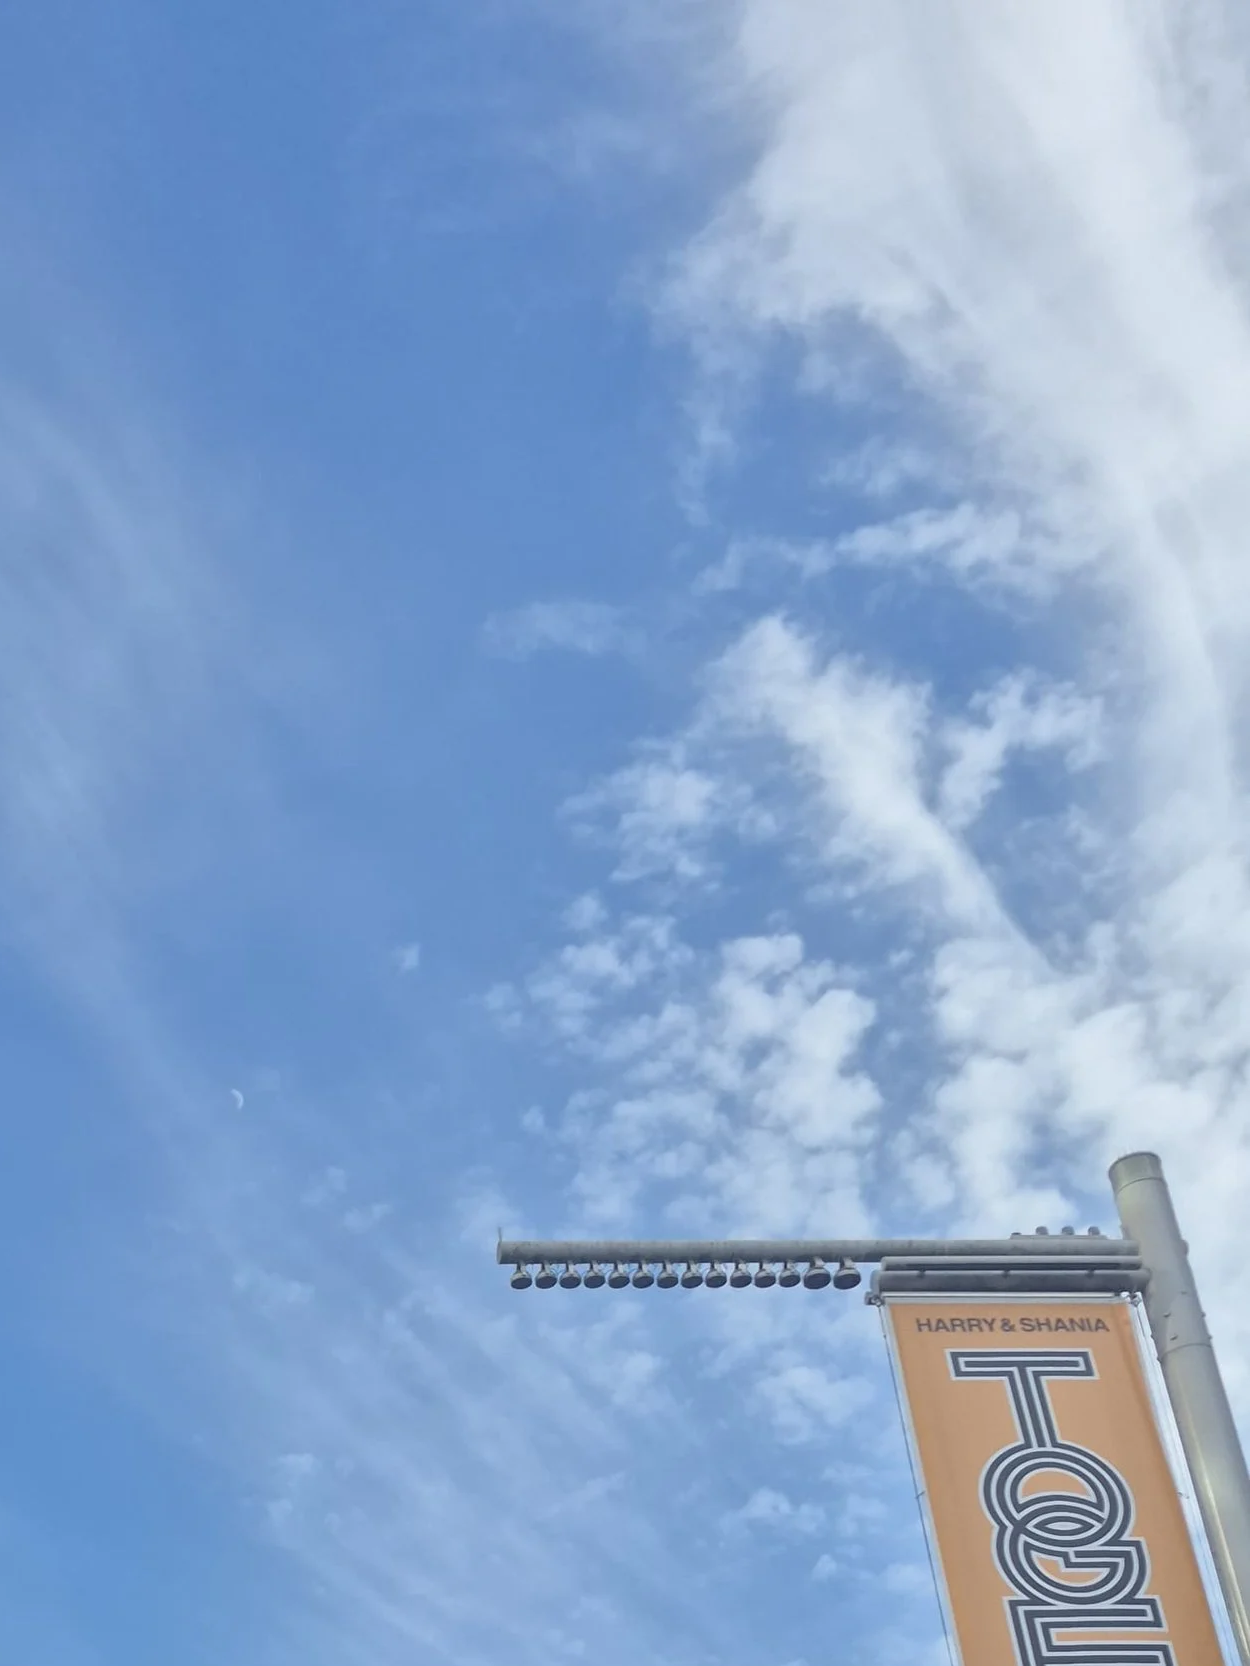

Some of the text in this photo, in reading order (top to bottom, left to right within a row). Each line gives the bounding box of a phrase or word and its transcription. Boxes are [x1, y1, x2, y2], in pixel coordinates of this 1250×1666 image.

[915, 1317, 1110, 1332] HARRY & SHANIA
